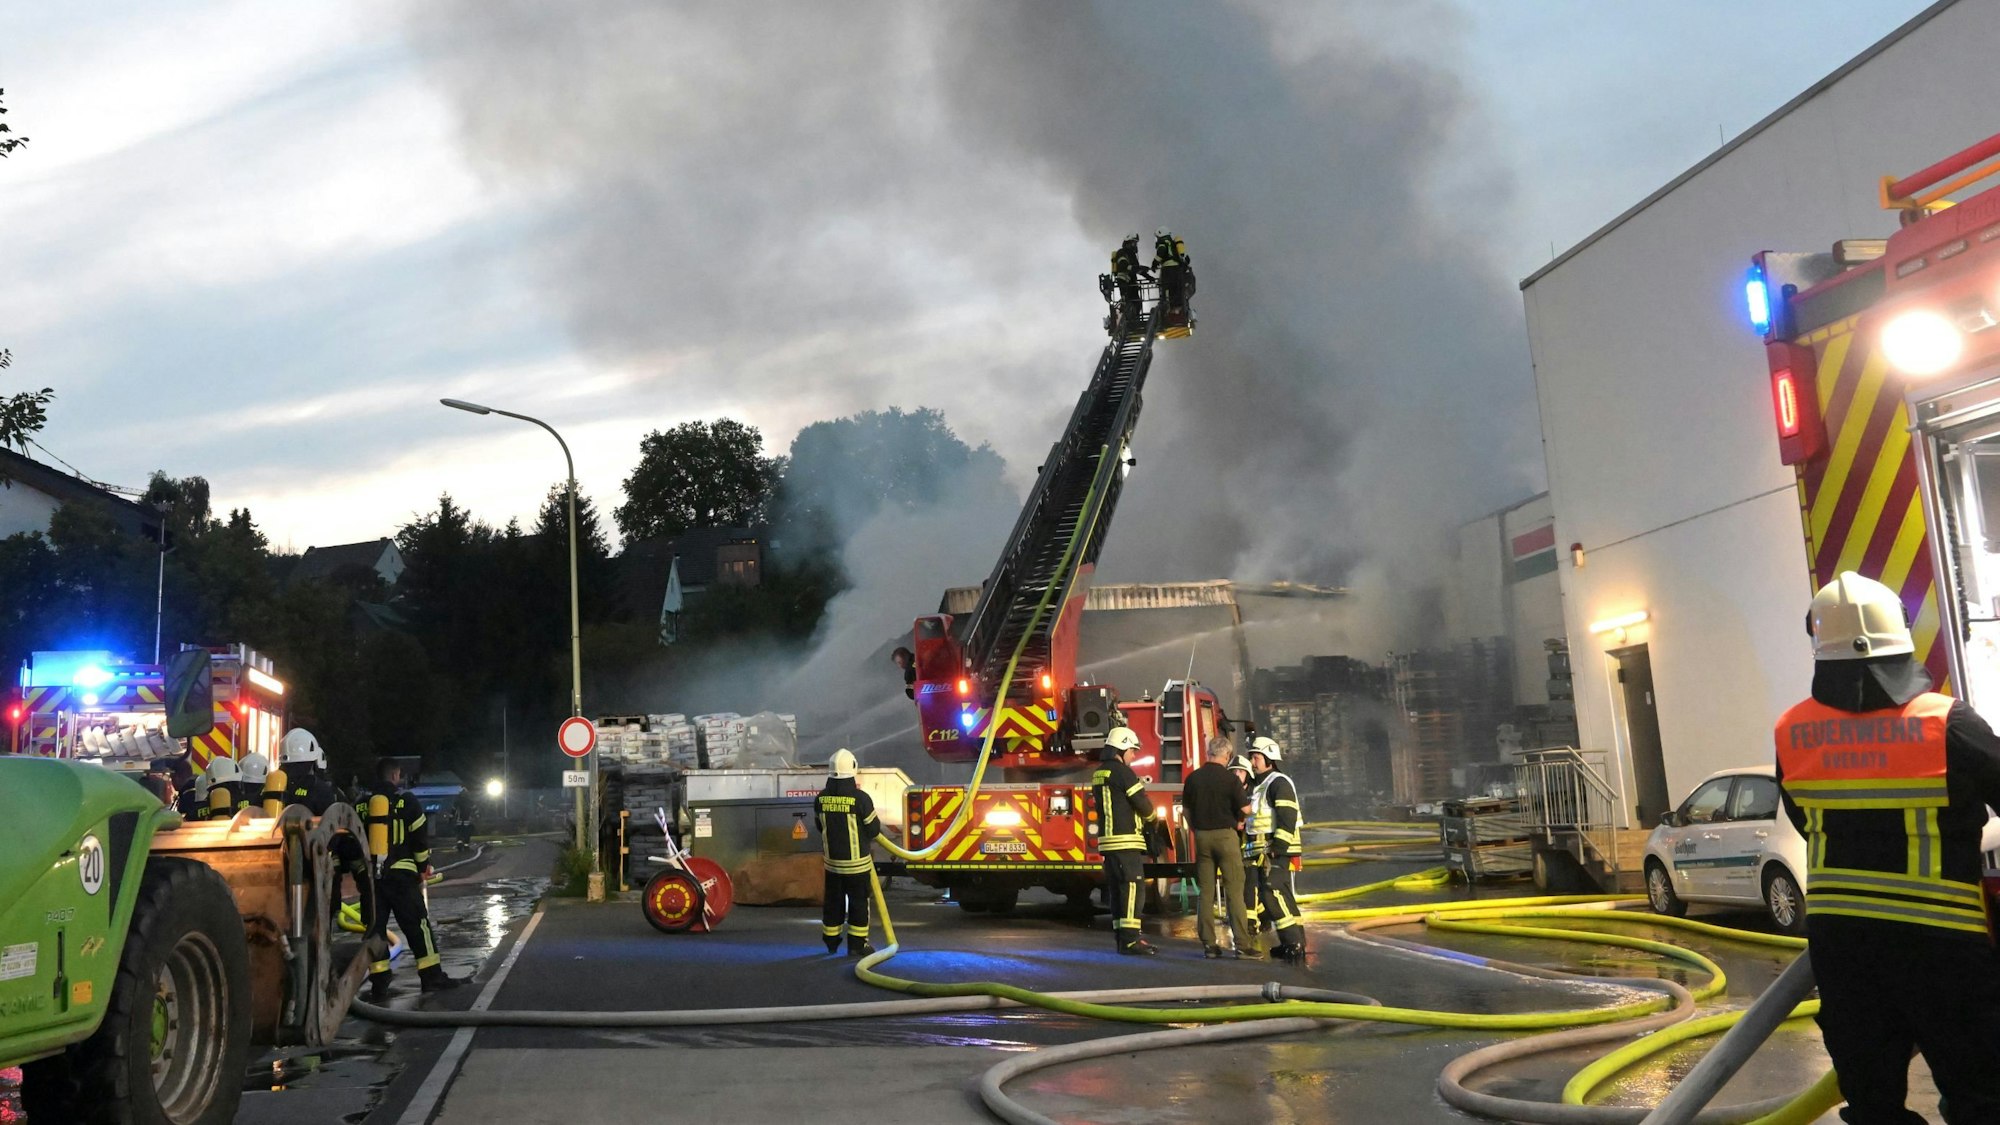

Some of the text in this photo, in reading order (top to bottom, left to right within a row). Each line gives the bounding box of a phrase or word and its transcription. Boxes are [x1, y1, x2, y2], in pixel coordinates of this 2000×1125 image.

[940, 729, 960, 741] 112
[1790, 716, 1924, 750] FEUERWEHR
[84, 847, 100, 883] 20
